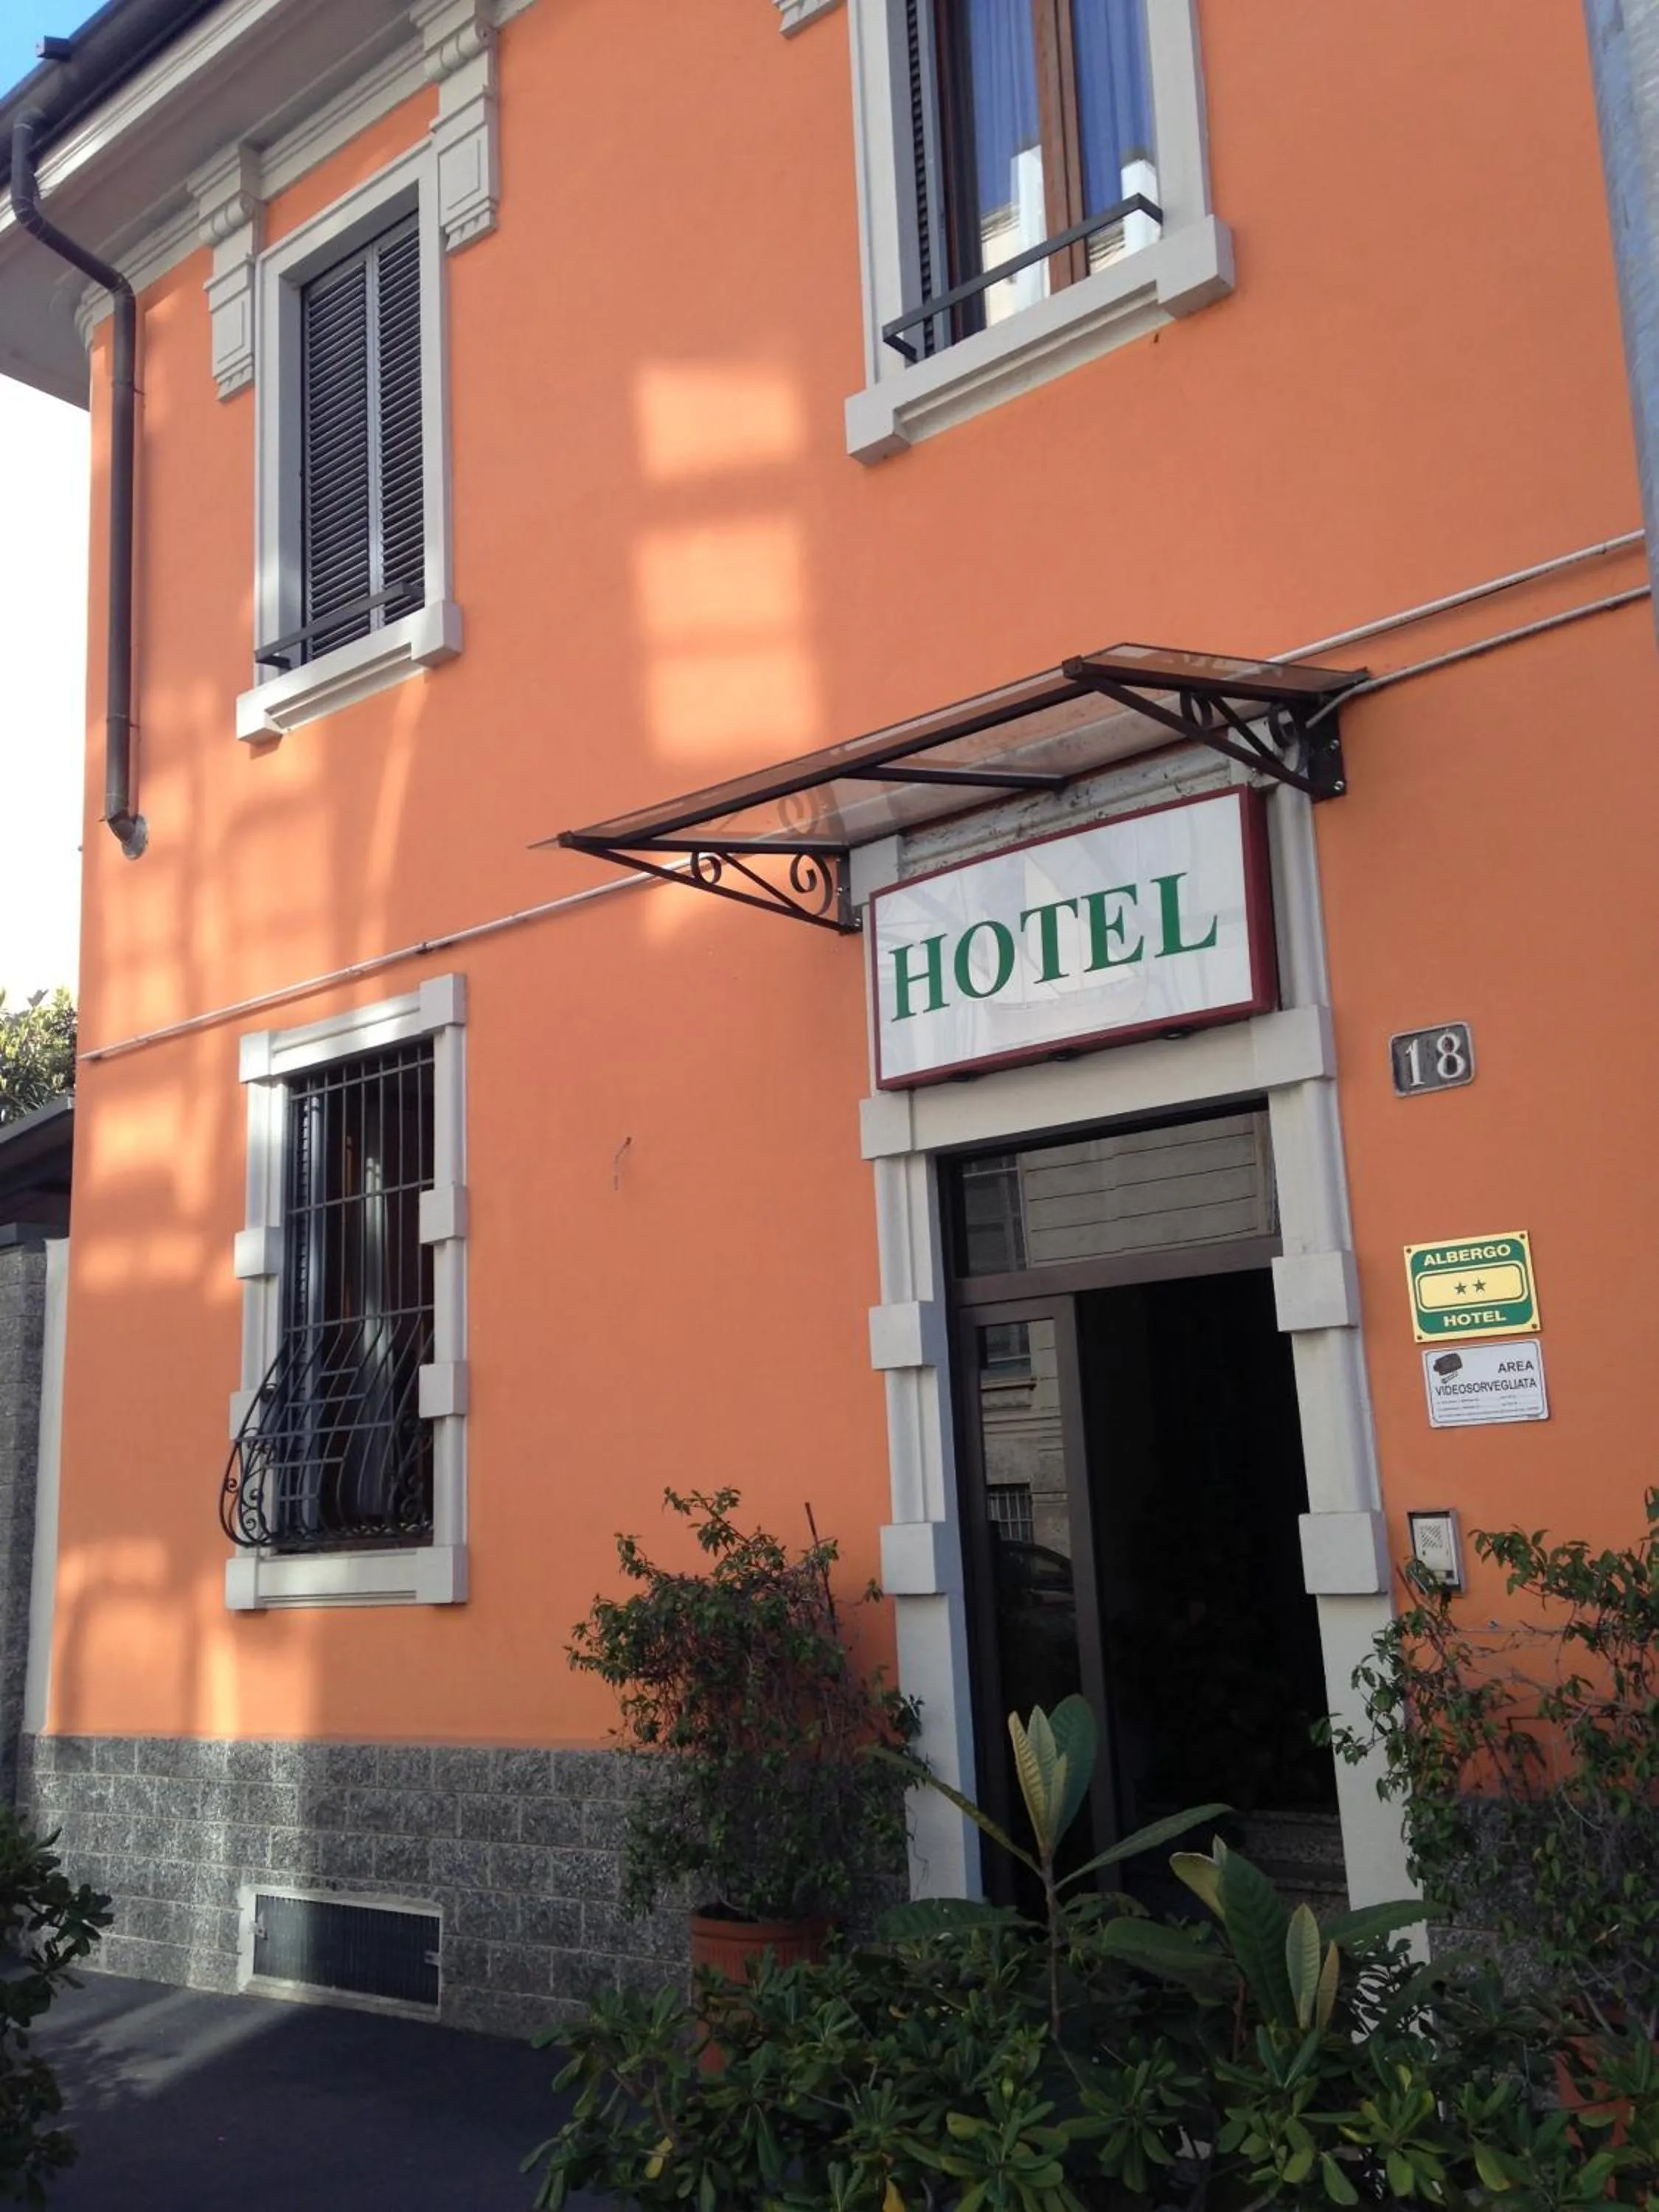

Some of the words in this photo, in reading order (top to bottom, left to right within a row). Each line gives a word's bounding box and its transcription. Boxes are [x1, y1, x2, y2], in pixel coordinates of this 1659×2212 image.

[888, 872, 1218, 1022] HOTEL
[1405, 1033, 1466, 1087] 18
[1423, 1244, 1512, 1267] ALBERGO
[1442, 1310, 1507, 1327] HOTEL
[1498, 1360, 1534, 1374] AREA
[1434, 1377, 1537, 1397] VIDEOSORVEGLIATA
